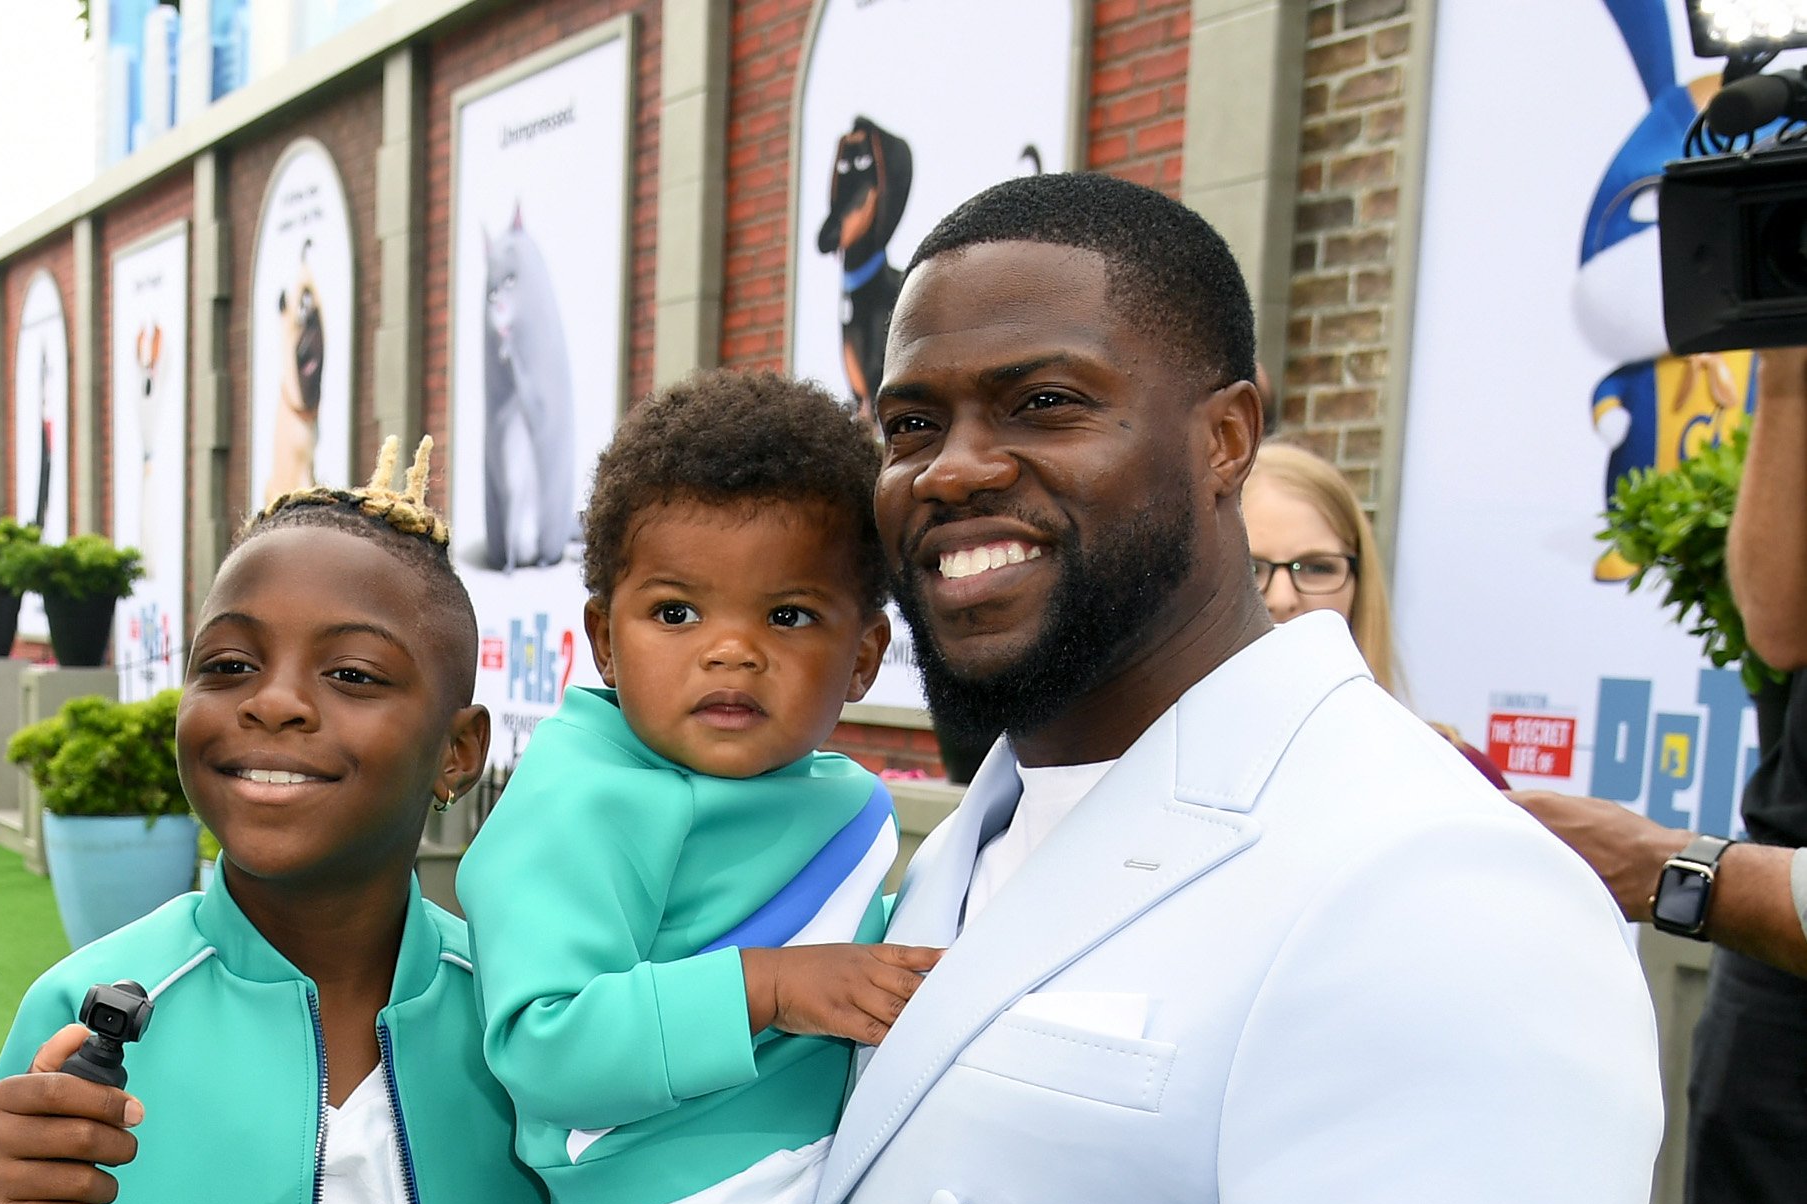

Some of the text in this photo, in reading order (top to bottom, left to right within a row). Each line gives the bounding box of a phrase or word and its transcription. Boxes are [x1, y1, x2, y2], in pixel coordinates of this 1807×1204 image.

[560, 629, 574, 704] 2
[1513, 717, 1570, 748] SECRET
[1507, 745, 1537, 771] LIFE
